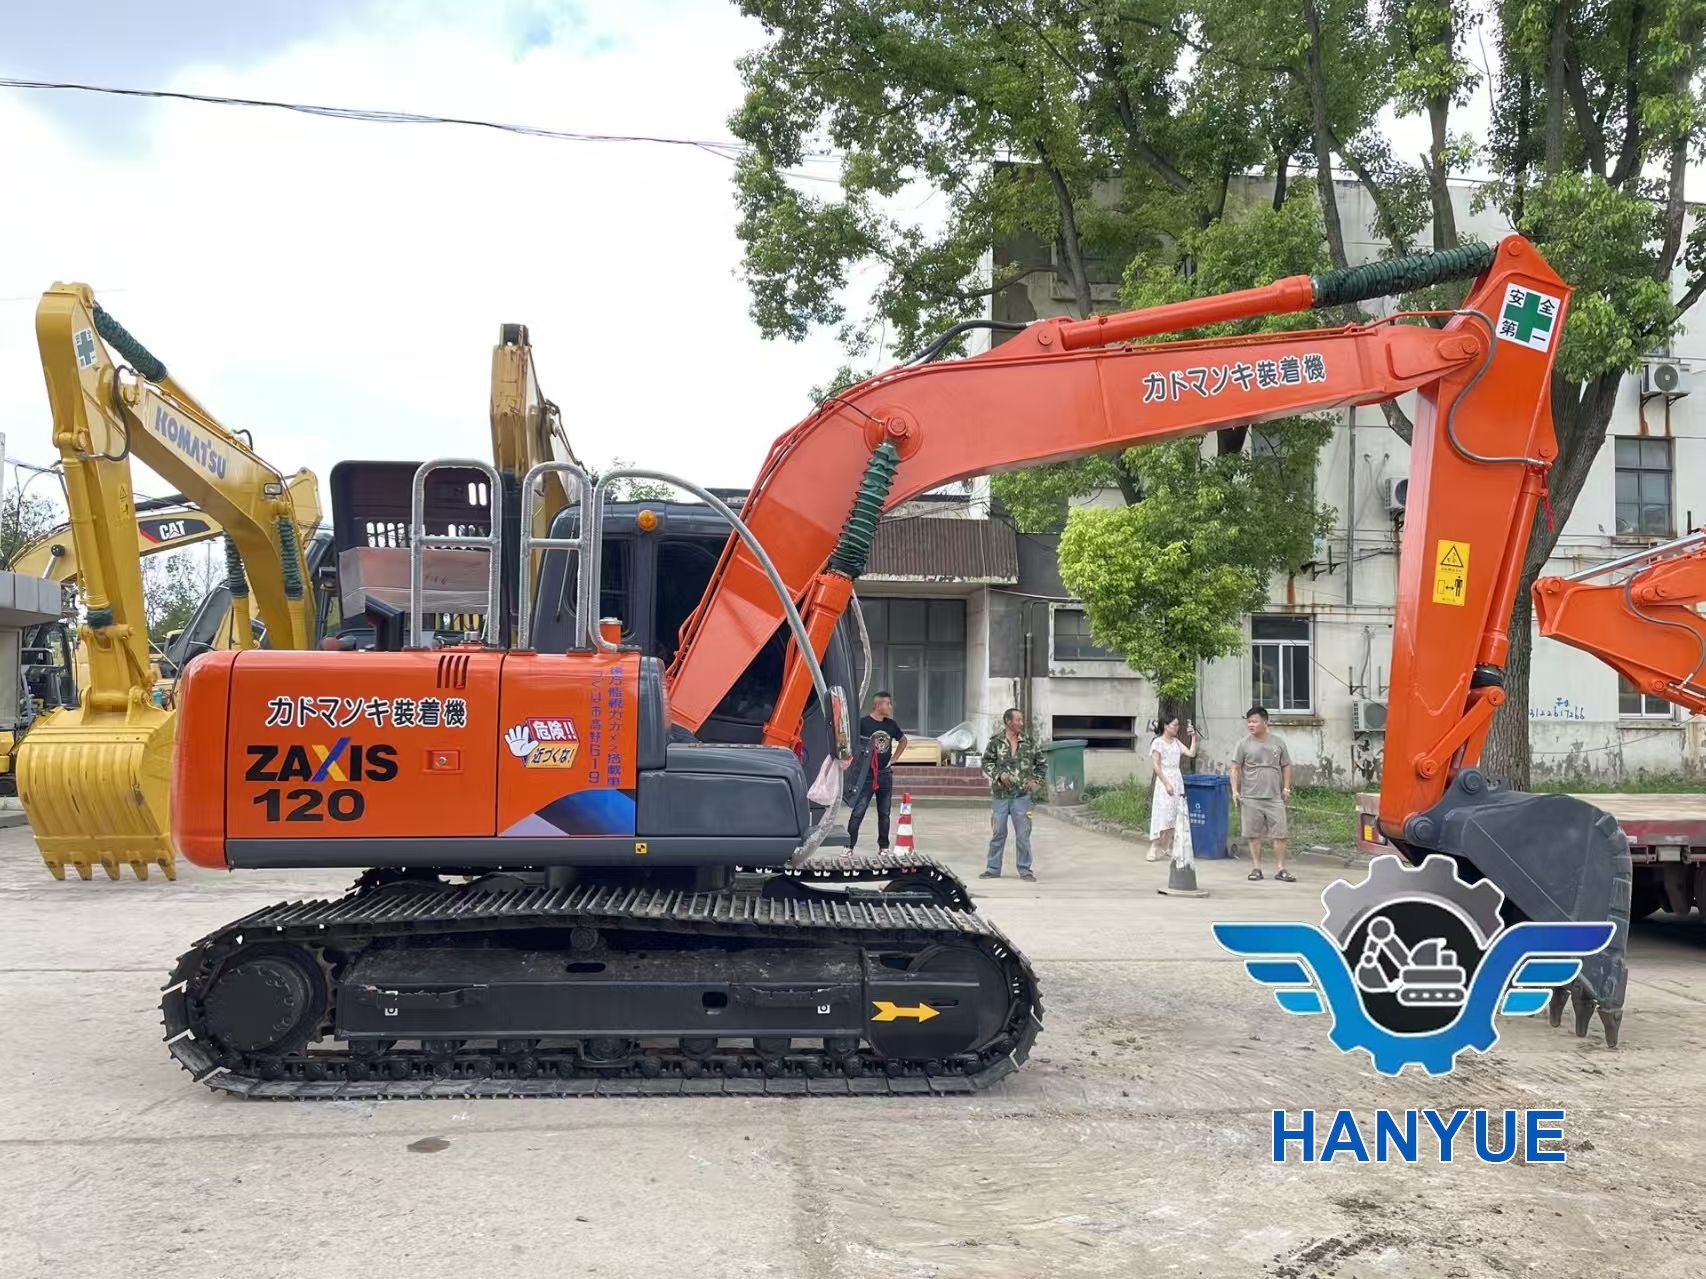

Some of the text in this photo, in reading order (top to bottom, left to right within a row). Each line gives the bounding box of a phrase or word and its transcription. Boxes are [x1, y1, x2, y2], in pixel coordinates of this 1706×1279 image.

[1508, 288, 1556, 316] 安全
[1499, 319, 1546, 342] 第一
[155, 405, 227, 480] KOMATSU
[159, 520, 186, 540] CAT
[245, 736, 398, 781] ZAXIS
[253, 788, 365, 822] 120
